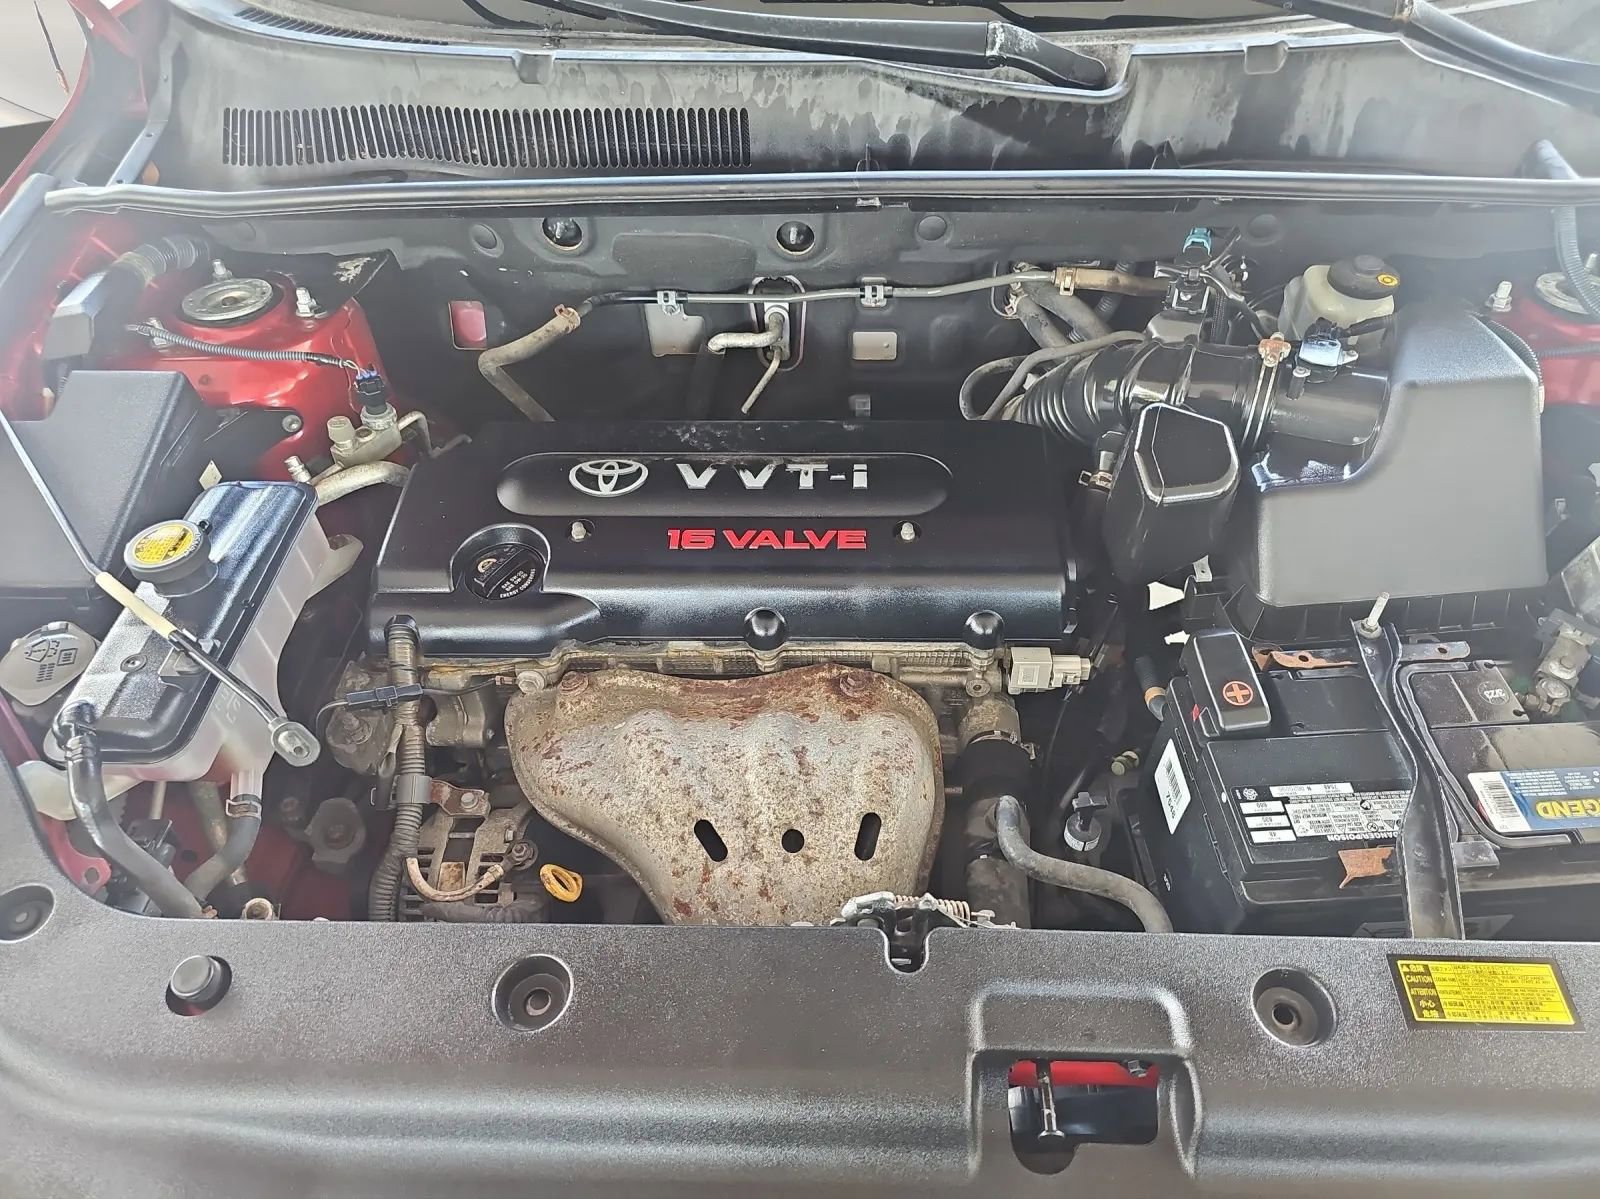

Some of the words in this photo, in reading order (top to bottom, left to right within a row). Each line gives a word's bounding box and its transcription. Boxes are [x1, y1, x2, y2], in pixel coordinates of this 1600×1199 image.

[676, 463, 868, 490] VVT-i
[667, 529, 716, 549] 16
[722, 529, 867, 549] VALVE
[1535, 799, 1600, 819] GEND
[1405, 974, 1433, 983] CAUTION
[1410, 987, 1438, 996] ATTENTION
